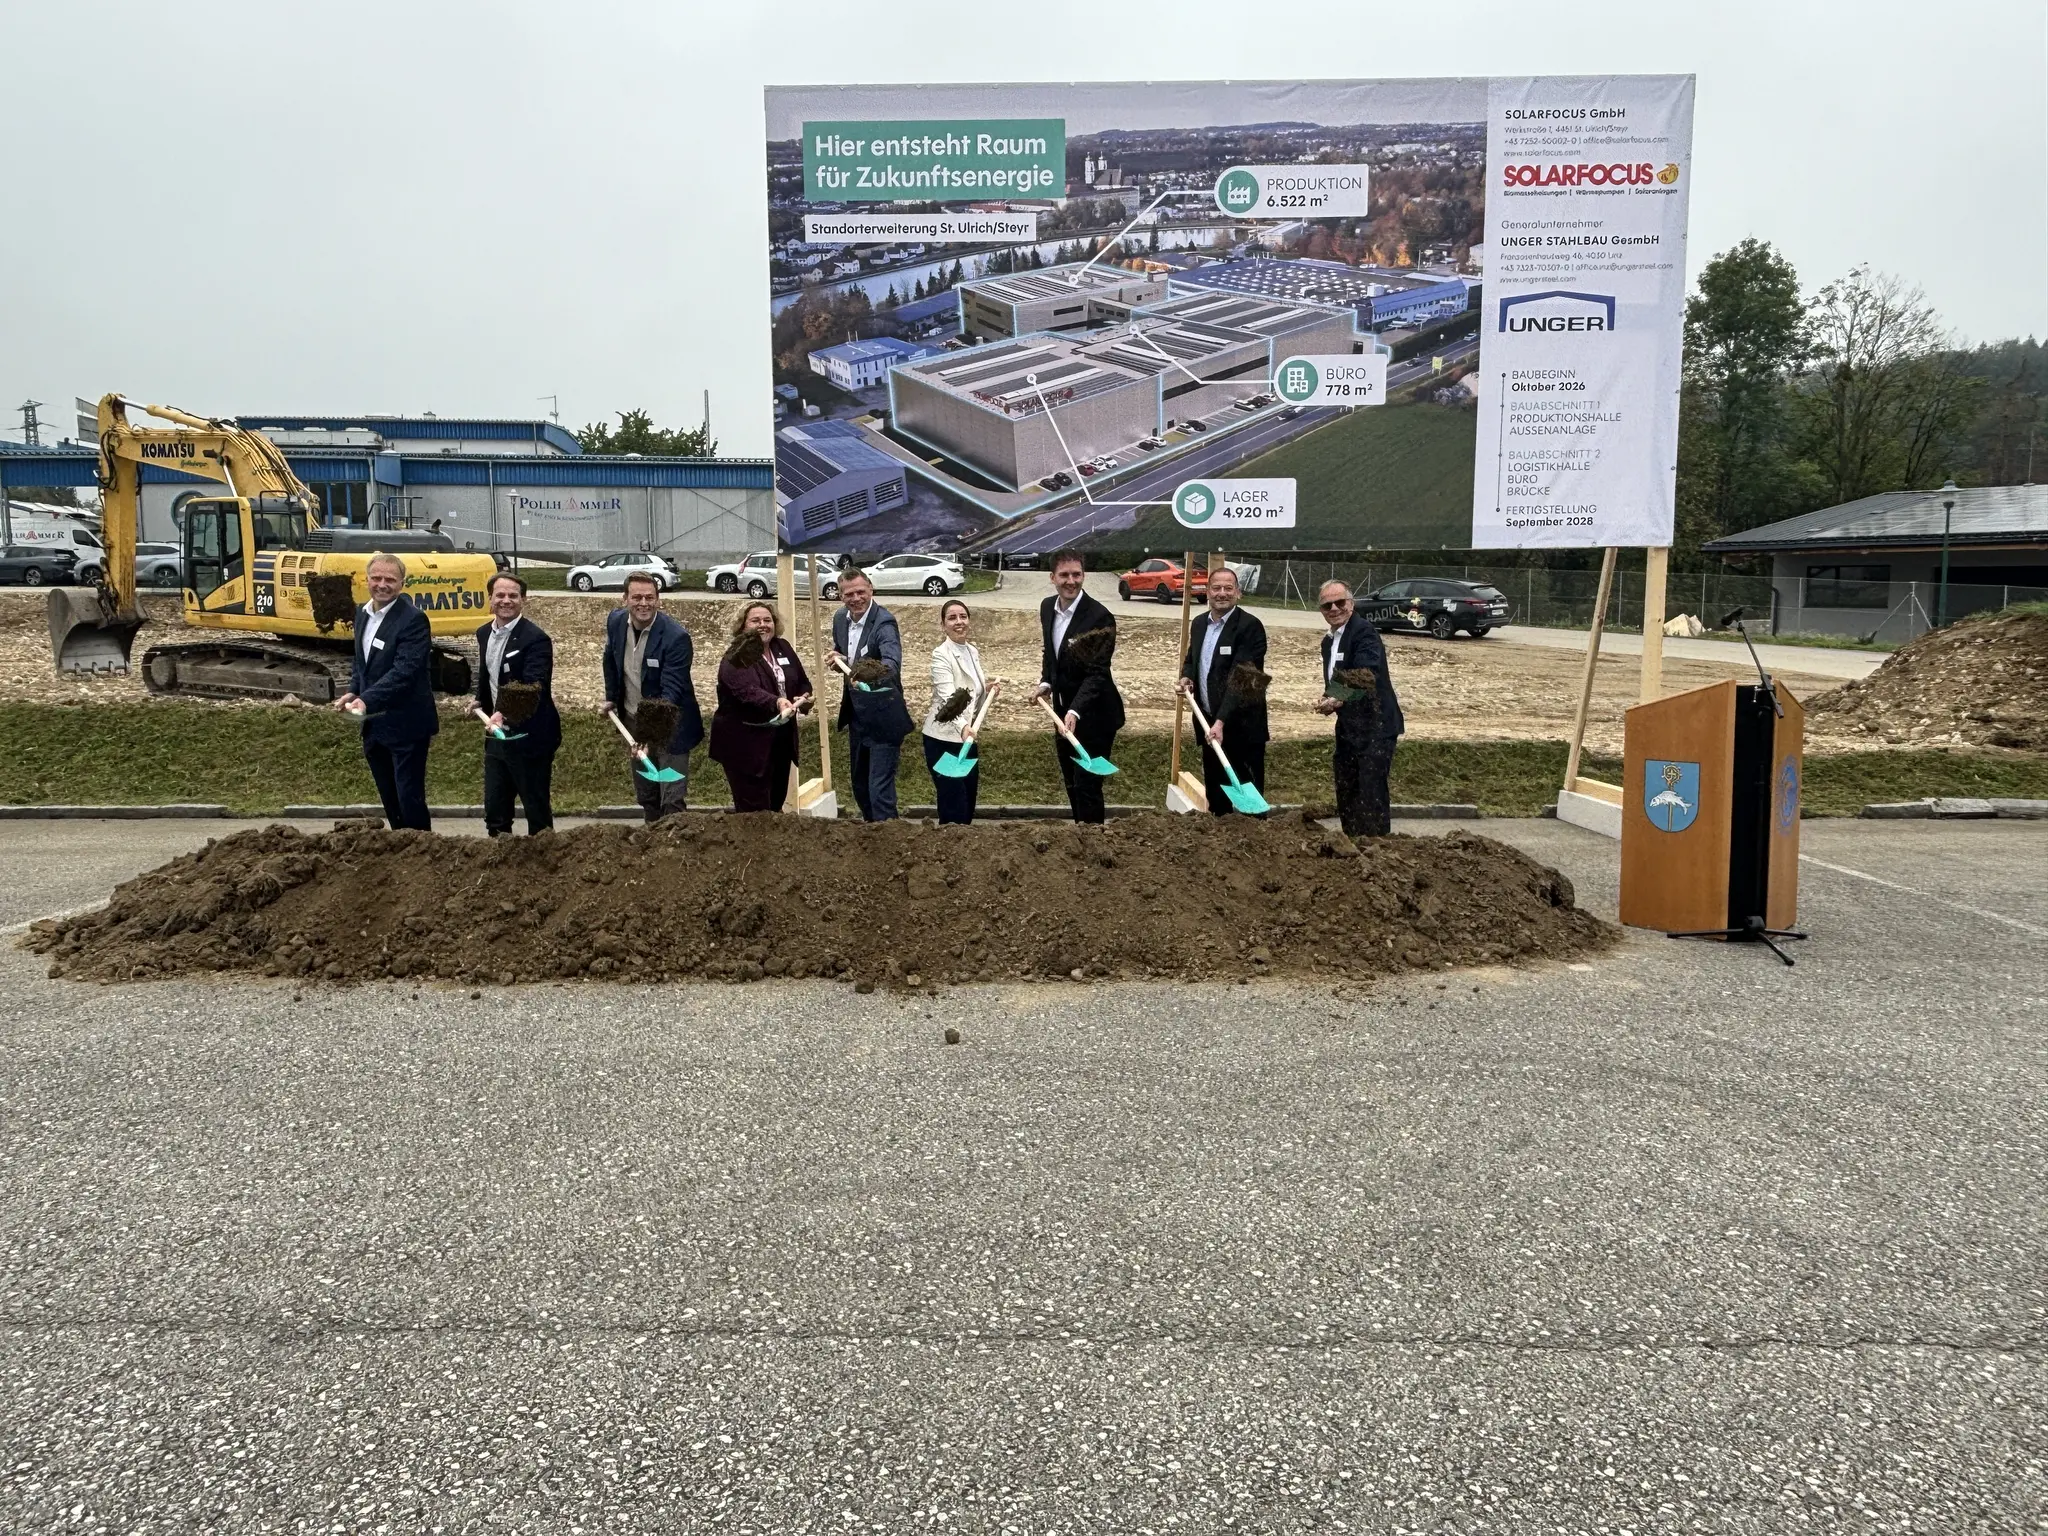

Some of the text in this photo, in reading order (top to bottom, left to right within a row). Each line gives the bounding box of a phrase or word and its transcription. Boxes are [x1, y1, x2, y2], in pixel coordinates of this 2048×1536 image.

[1505, 108, 1625, 119] SOLARFOCUS GmbH
[815, 133, 1046, 156] Hier entsteht Raum
[816, 164, 1054, 192] für Zukunftsenergie
[1504, 163, 1653, 187] SOLARFOCUS
[1267, 177, 1362, 190] PRODUKTION
[1267, 195, 1306, 207] 6.522
[811, 222, 1029, 236] Standorterweiterung St. Ulrich/Steyr
[1501, 219, 1604, 230] Generalunternehmer
[1501, 235, 1659, 246] UNGER STAHLBAU GesmbH
[1509, 316, 1604, 332] UNGER
[1326, 366, 1366, 380] BÜRO
[1512, 369, 1576, 380] BAUBEGINN
[1325, 384, 1350, 396] 778
[1511, 382, 1586, 391] Oktober 2026
[1510, 401, 1594, 411] BAUABSCHNITT
[1510, 412, 1622, 423] PRODUKTIONSHALLE
[1509, 425, 1596, 435] AUSSENANLAGE
[141, 440, 195, 458] KOMATSU
[1508, 449, 1601, 460] BAUABSCHNITT 2
[1508, 461, 1591, 472] LOGISTIKHALLE
[1507, 473, 1538, 484] BÜRO
[1507, 485, 1551, 496] BRÜCKE
[1223, 490, 1269, 503] LAGER
[1223, 507, 1262, 518] 4.920
[1506, 504, 1597, 515] FERTIGSTELLUNG
[1506, 517, 1594, 528] September 2028
[256, 595, 273, 607] 210
[1365, 604, 1400, 623] RADIO
